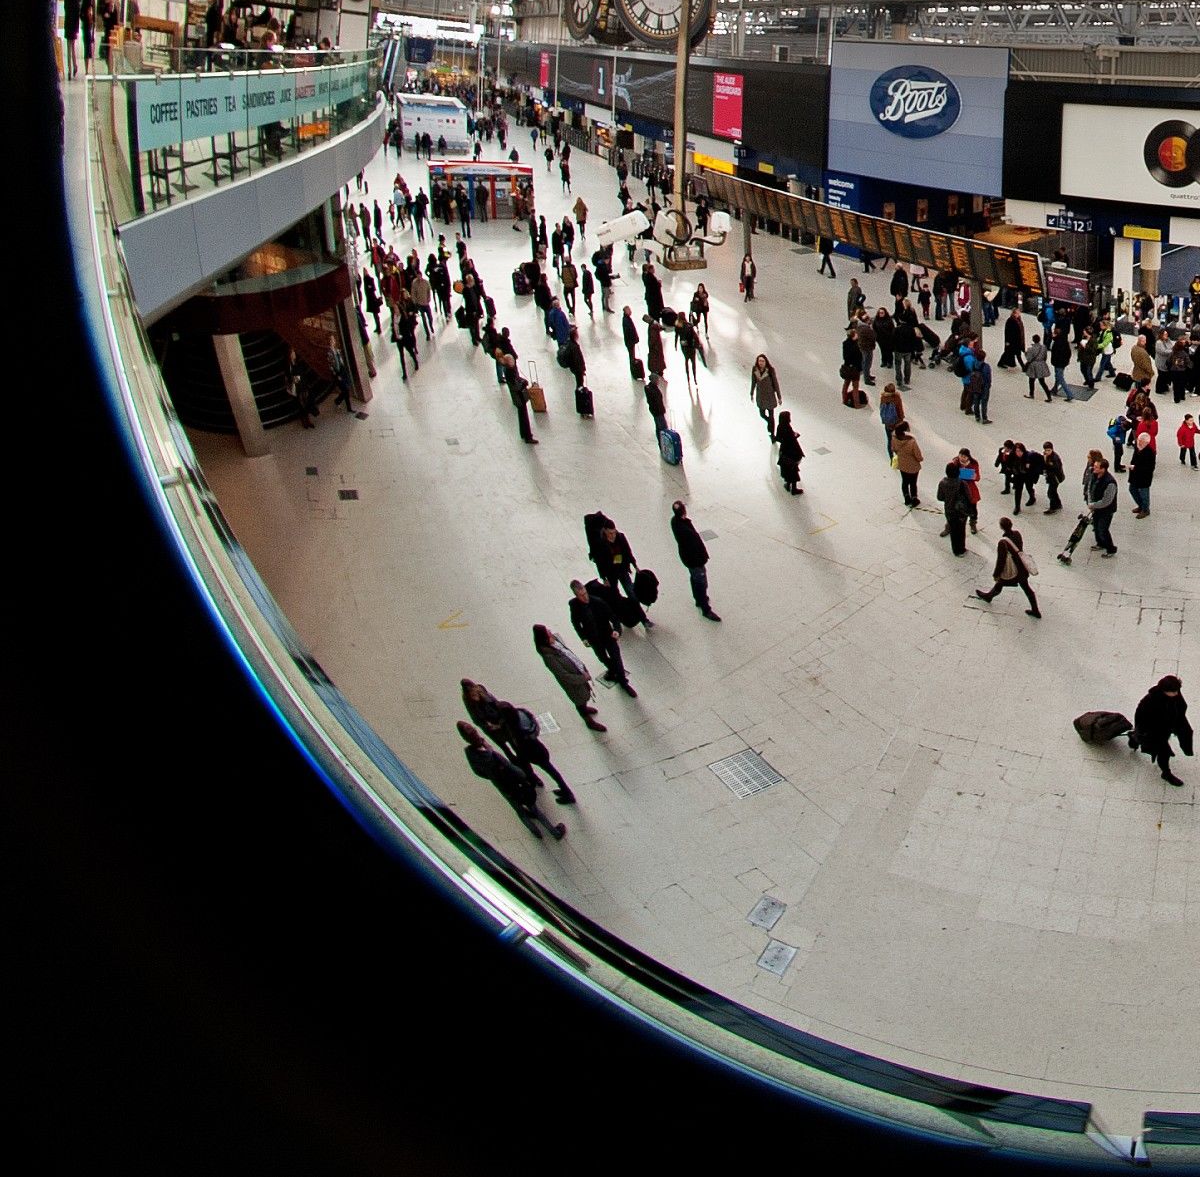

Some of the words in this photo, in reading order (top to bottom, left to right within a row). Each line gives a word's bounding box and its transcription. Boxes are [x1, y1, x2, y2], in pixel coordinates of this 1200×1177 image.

[150, 101, 178, 124] COFFEE
[186, 97, 218, 119] PASTRIES
[225, 95, 236, 112] TEA
[242, 89, 275, 110] SANDWICHES
[280, 88, 291, 104] JUICE
[880, 78, 947, 124] Boots
[828, 179, 854, 189] welcome
[1073, 221, 1084, 232] 12
